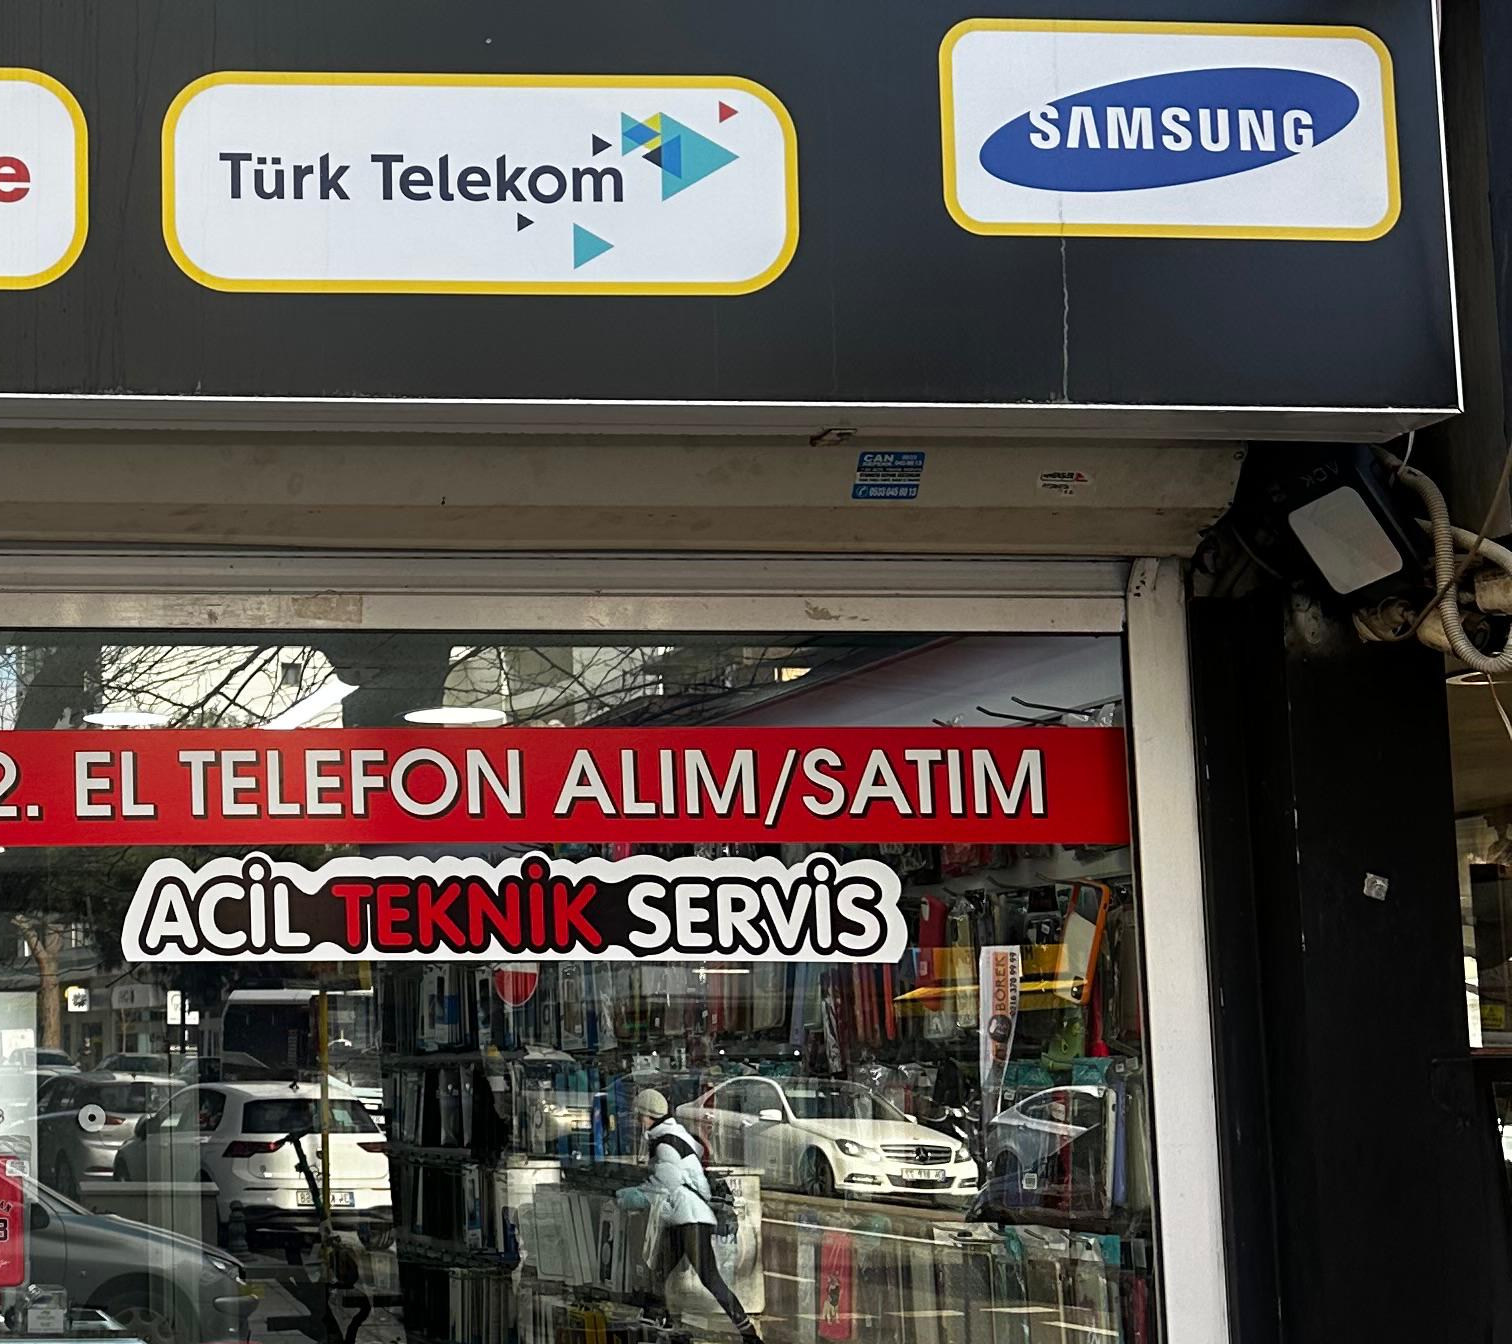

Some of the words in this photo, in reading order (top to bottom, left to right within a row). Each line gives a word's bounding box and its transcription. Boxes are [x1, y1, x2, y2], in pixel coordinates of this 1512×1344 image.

[1028, 102, 1315, 154] SAMSUNG
[219, 152, 350, 200] Türk
[371, 153, 623, 202] Telekom
[75, 749, 156, 817] EL
[178, 747, 522, 817] TELEFON
[555, 747, 1046, 827] ALIM/SATIM
